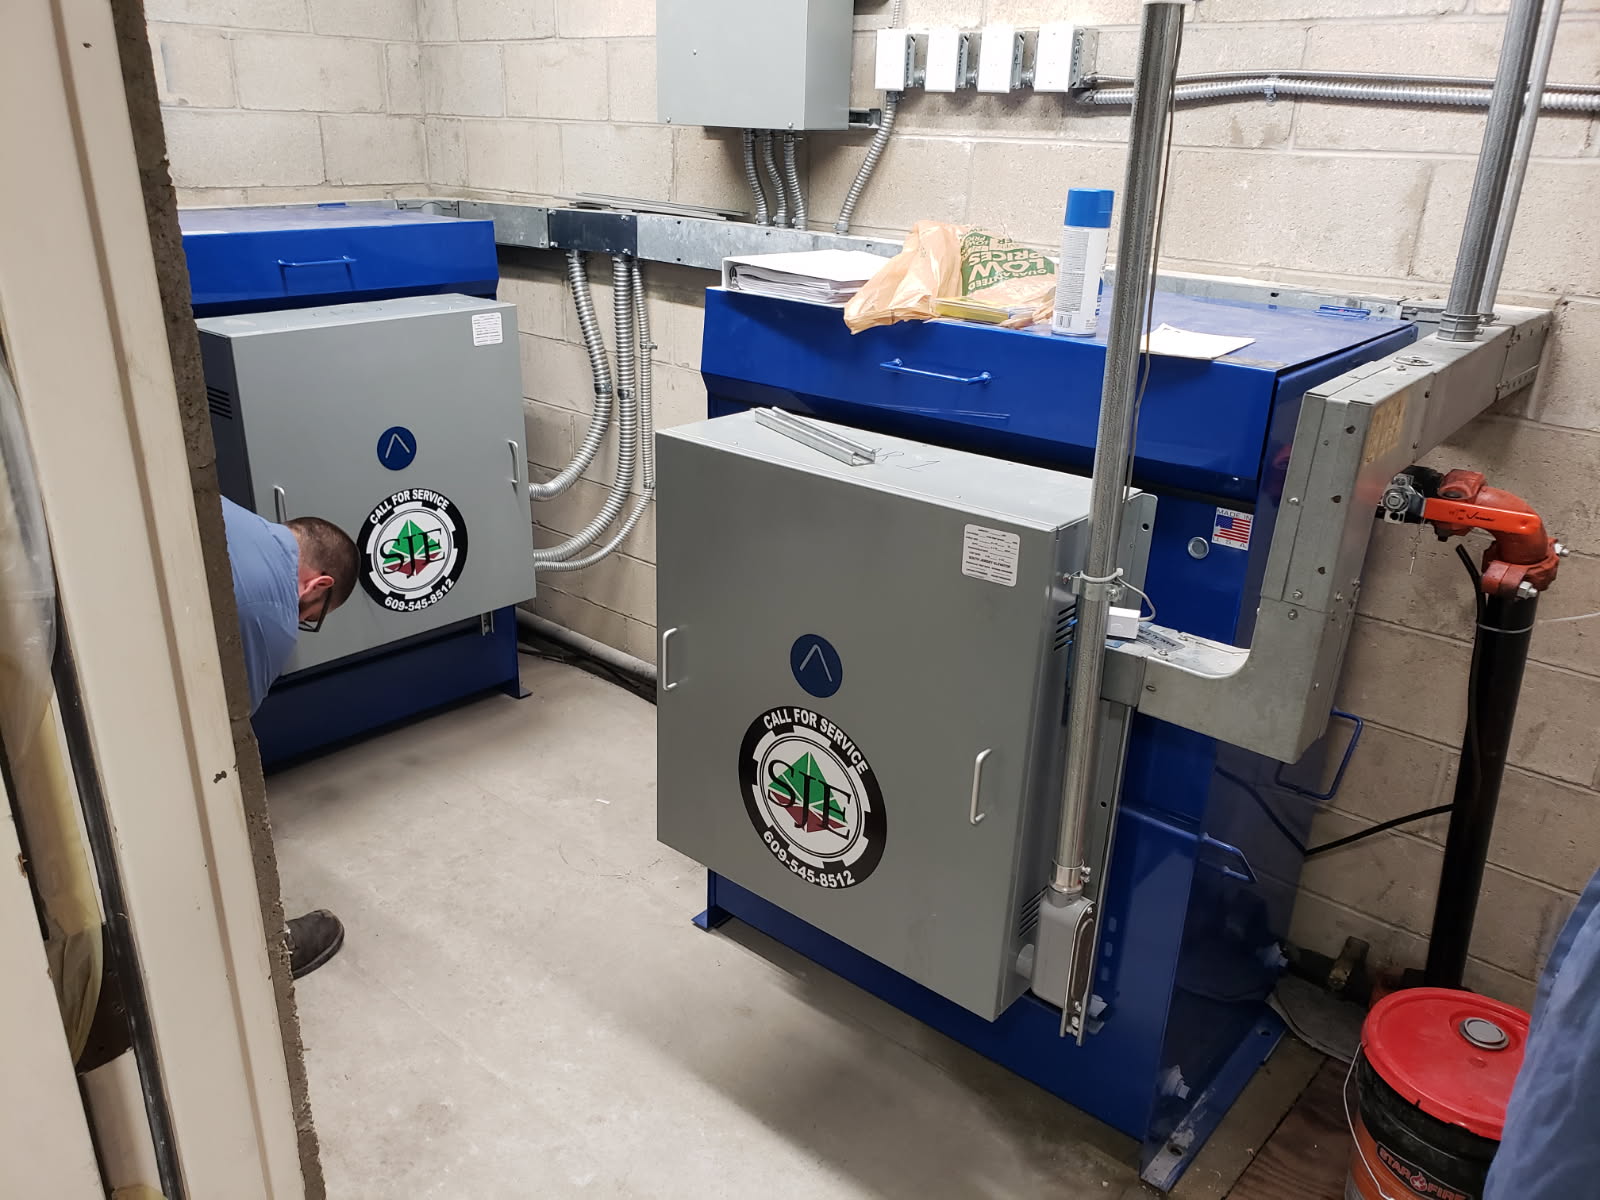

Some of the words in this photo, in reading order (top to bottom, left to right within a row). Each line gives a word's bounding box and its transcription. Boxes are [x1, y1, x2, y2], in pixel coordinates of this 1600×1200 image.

[968, 250, 1042, 266] PRICES
[968, 258, 1045, 284] LOW
[370, 501, 392, 524] CALL
[391, 490, 411, 506] FOR
[412, 489, 449, 510] SERVICE
[380, 528, 446, 580] SJE
[384, 578, 455, 612] 609-545-8512
[763, 708, 792, 730] CALL
[793, 708, 817, 729] FOR
[820, 718, 869, 775] SERVICE
[767, 759, 852, 841] SJE
[763, 830, 856, 888] 609-545-8512
[1379, 1147, 1412, 1180] STAR
